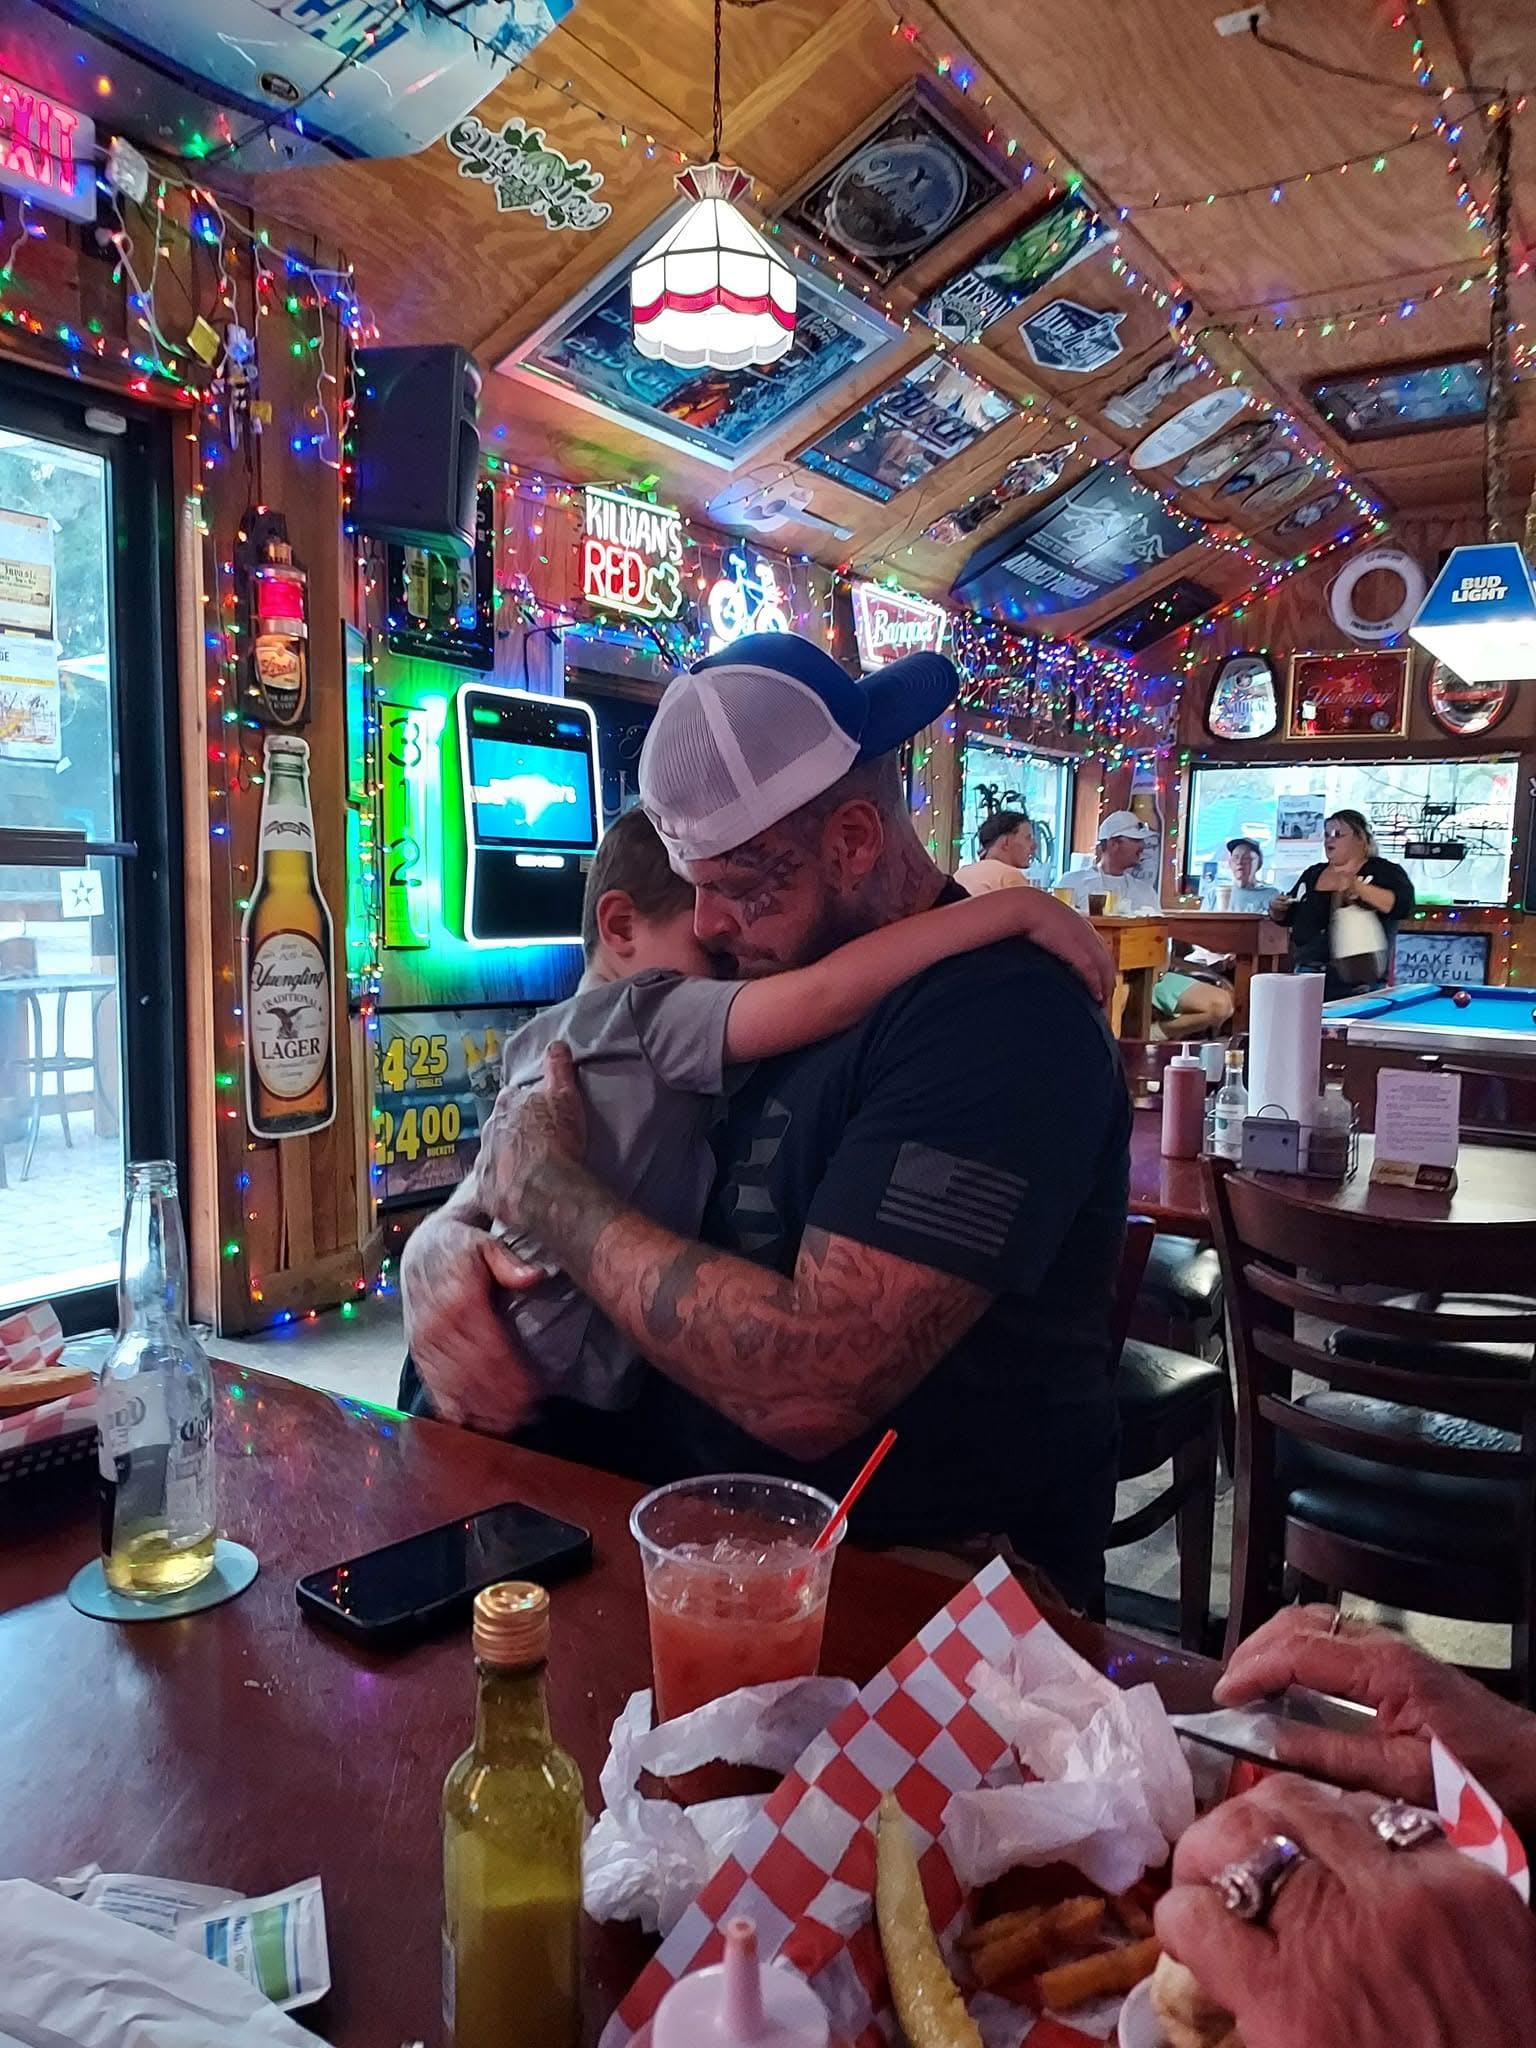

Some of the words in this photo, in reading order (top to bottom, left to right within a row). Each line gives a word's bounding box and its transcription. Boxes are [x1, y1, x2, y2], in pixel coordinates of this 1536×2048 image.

[943, 272, 1014, 333] ELYSIAN
[1031, 305, 1078, 338] BLUE
[585, 493, 683, 562] KILLIAN'S
[583, 540, 647, 606] RED
[1001, 551, 1052, 590] ARMED
[1461, 575, 1503, 591] BUD
[1451, 586, 1508, 603] LIGHT
[871, 609, 935, 650] Banquet
[1307, 681, 1397, 709] Yuengling
[1406, 952, 1452, 966] MAKE
[1461, 953, 1479, 966] IT
[252, 962, 325, 992] Yuengling
[1408, 968, 1473, 982] JOYFUL
[262, 993, 318, 1010] TRADITIONAL
[261, 1037, 321, 1060] LAGER
